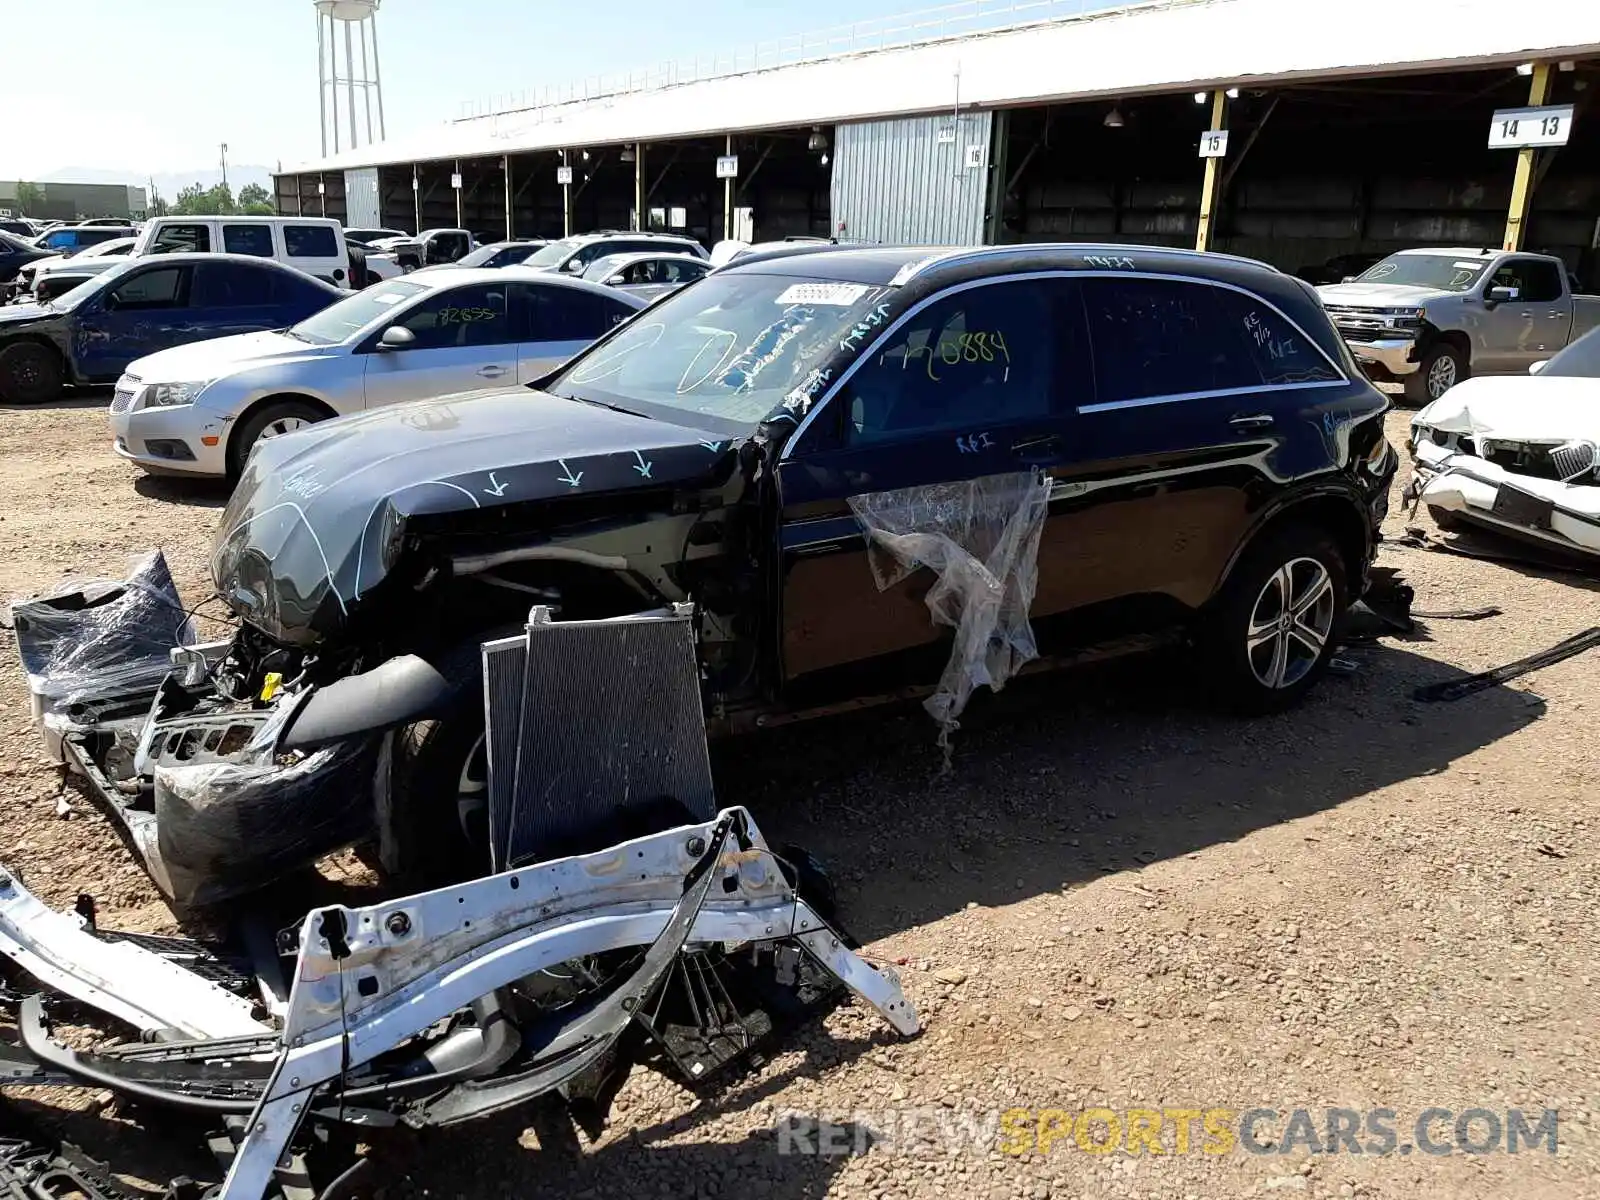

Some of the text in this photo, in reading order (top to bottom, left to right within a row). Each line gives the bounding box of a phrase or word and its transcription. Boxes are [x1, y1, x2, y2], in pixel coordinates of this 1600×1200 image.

[1502, 116, 1560, 138] 14 13
[1208, 135, 1221, 151] 15
